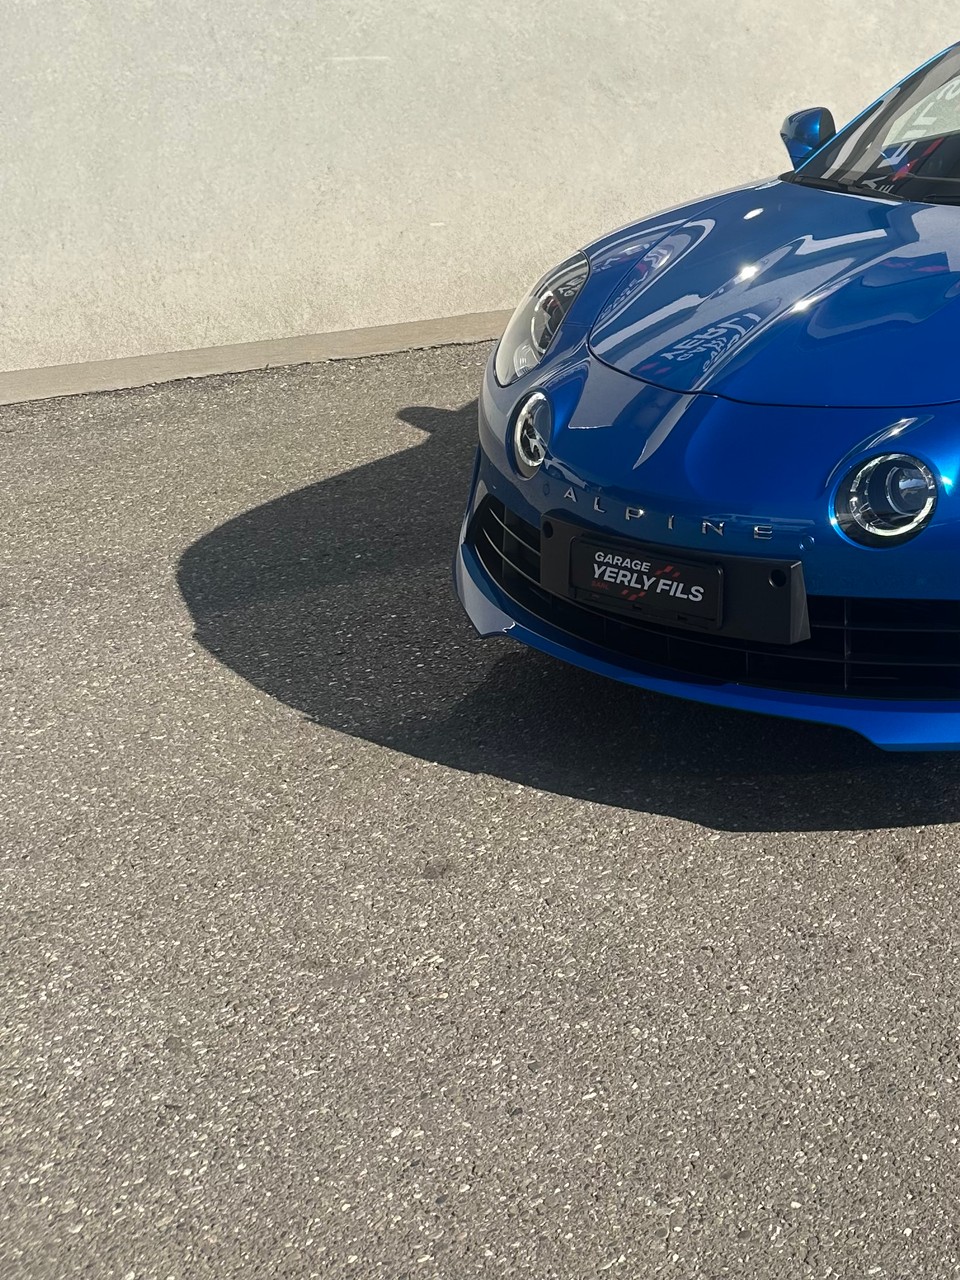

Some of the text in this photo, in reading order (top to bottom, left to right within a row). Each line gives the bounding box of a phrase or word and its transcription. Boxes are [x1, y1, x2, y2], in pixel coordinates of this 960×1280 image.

[563, 486, 773, 540] ALPINE
[594, 551, 651, 573] GARAGE
[593, 563, 705, 602] YERLY FILS
